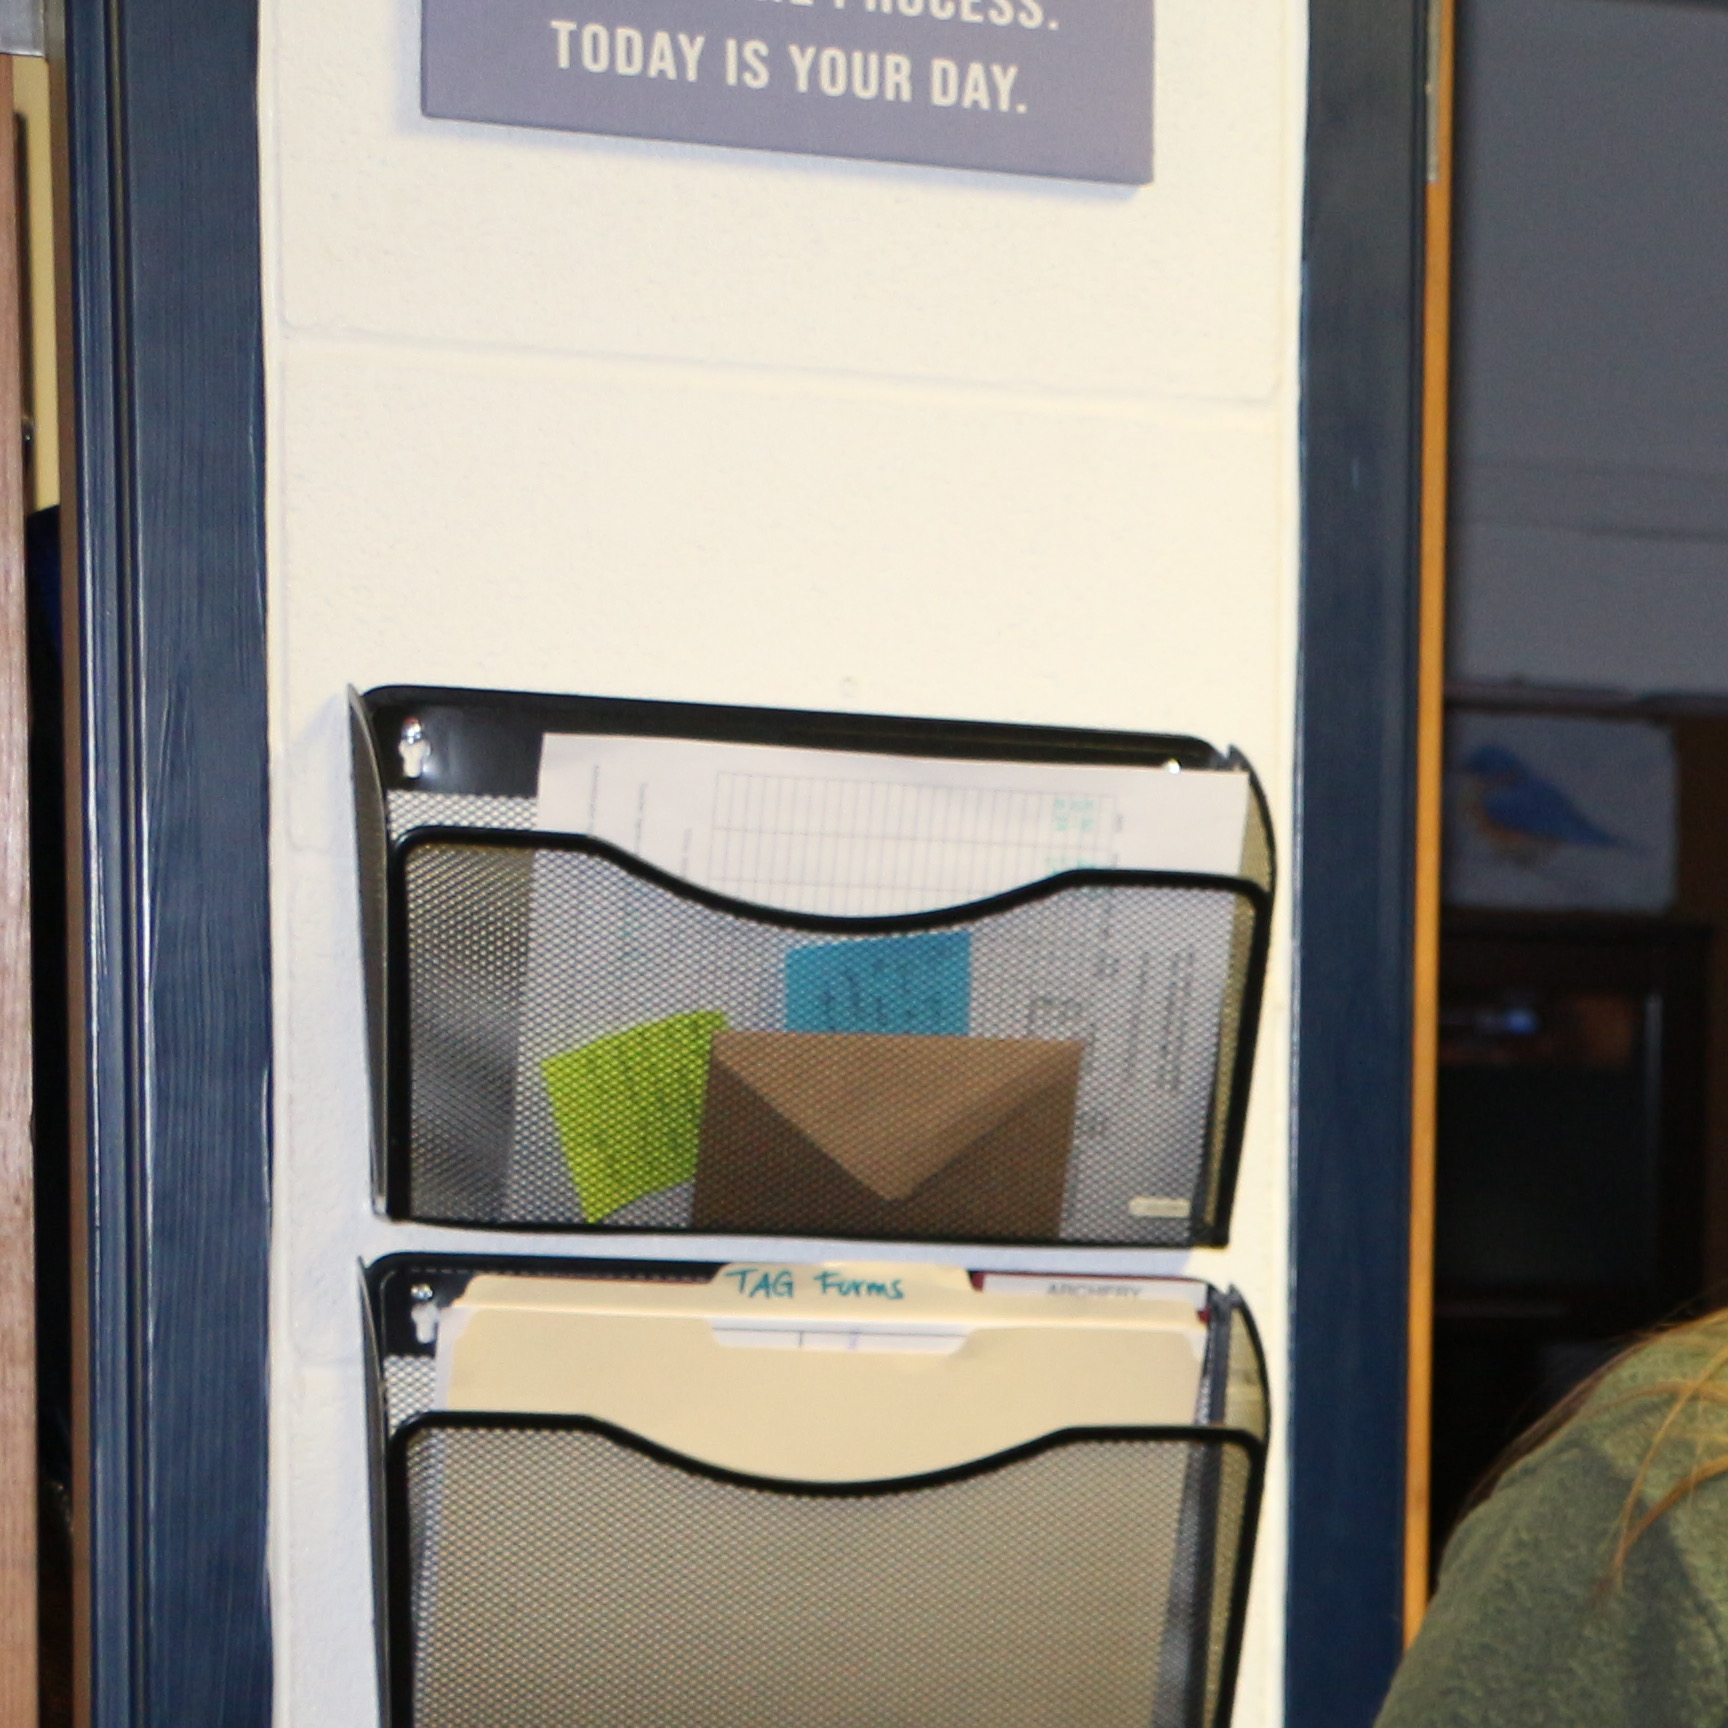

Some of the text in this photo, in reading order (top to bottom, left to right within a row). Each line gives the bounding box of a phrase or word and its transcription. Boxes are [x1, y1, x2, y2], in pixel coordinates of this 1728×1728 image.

[550, 20, 1028, 114] TODAY IS YOUR DAY.
[724, 1267, 795, 1300] TAG
